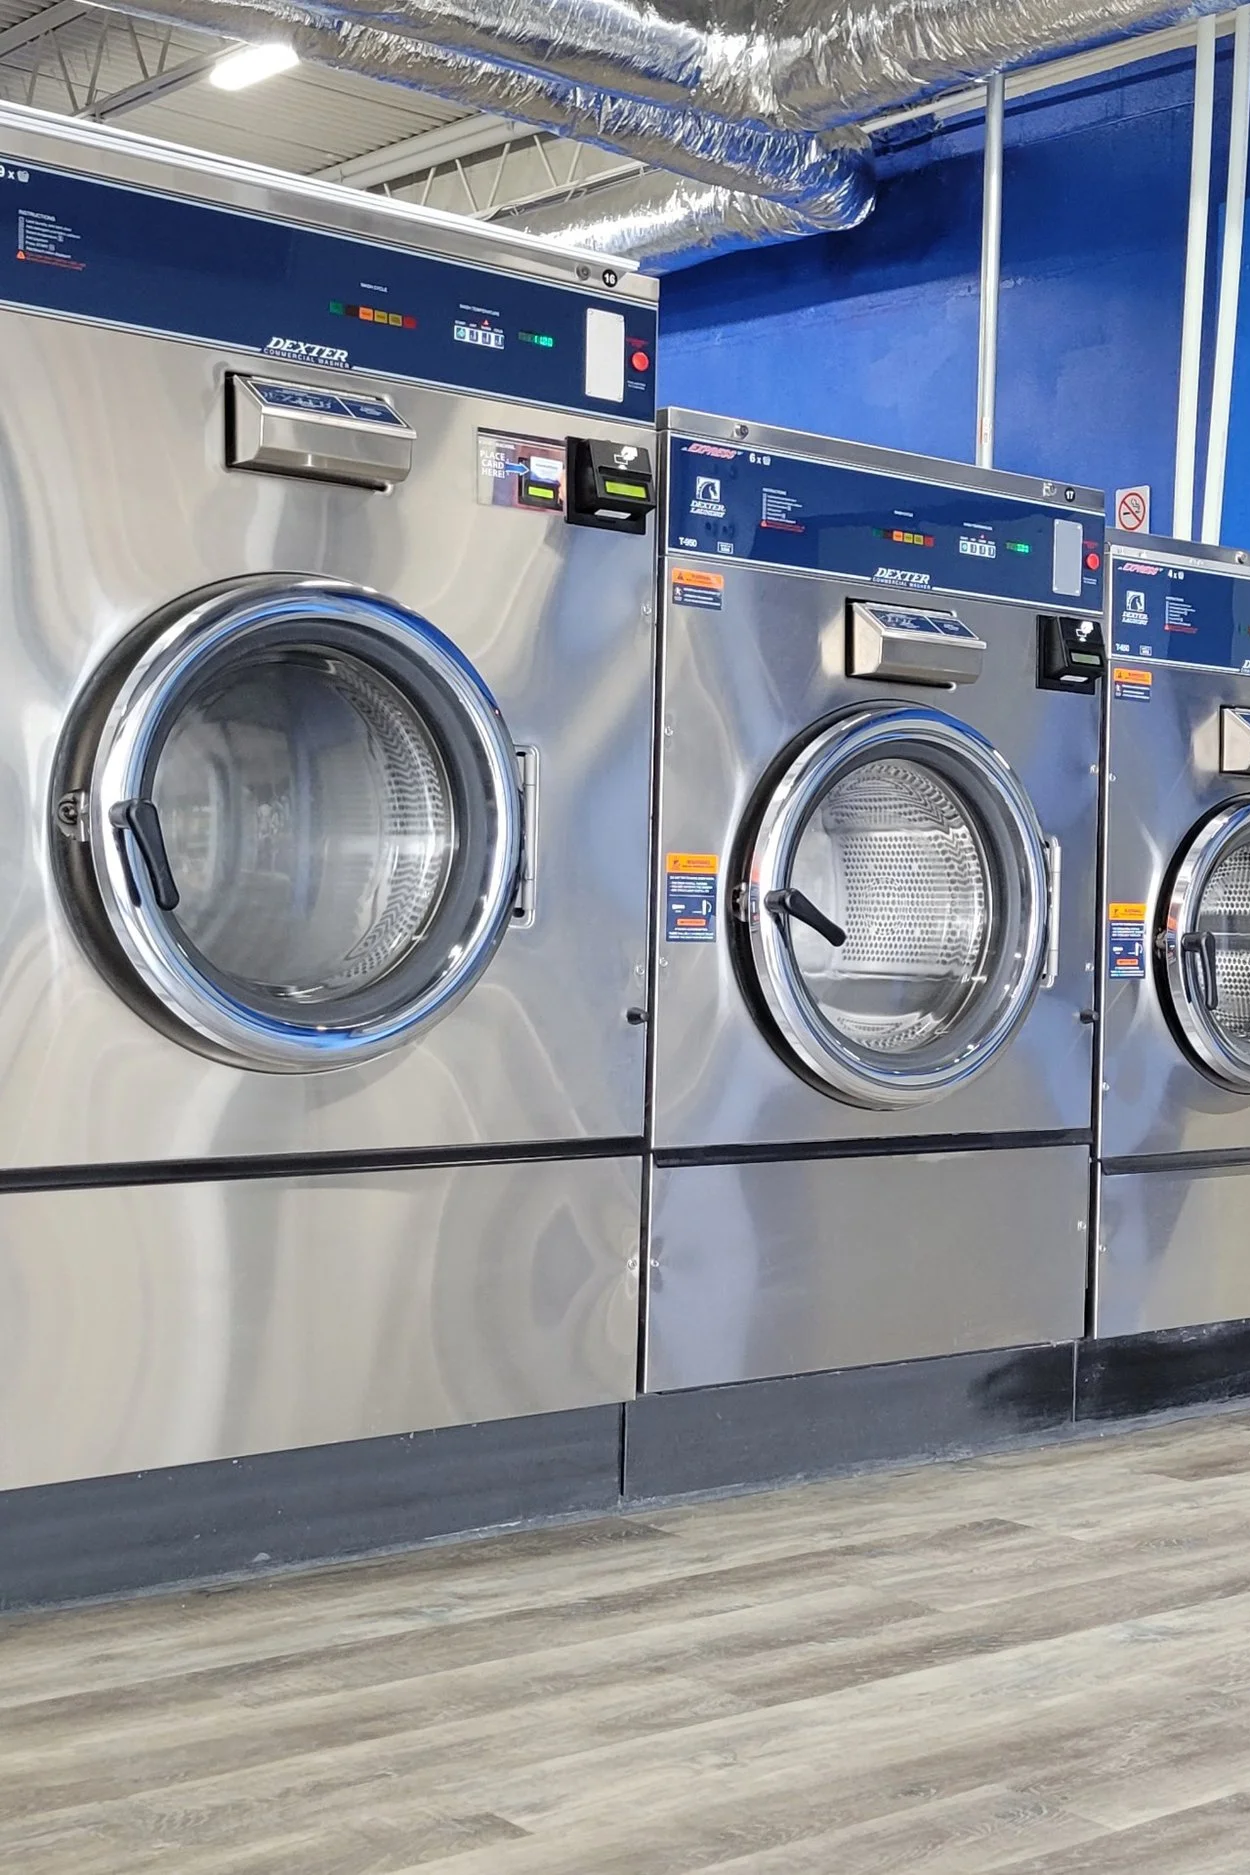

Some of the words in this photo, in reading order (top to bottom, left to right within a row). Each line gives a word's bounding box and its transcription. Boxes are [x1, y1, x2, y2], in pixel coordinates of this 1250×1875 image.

[604, 272, 616, 285] 16
[266, 336, 349, 362] DEXTER
[263, 348, 315, 363] COMMERCIAL
[318, 358, 350, 369] WASHER
[480, 450, 506, 461] PLACE
[749, 453, 756, 463] 6
[481, 459, 505, 470] CARD
[481, 468, 506, 479] HERE!
[1066, 491, 1075, 501] 17
[690, 500, 726, 511] DEXTER
[873, 567, 931, 585] DEXTER
